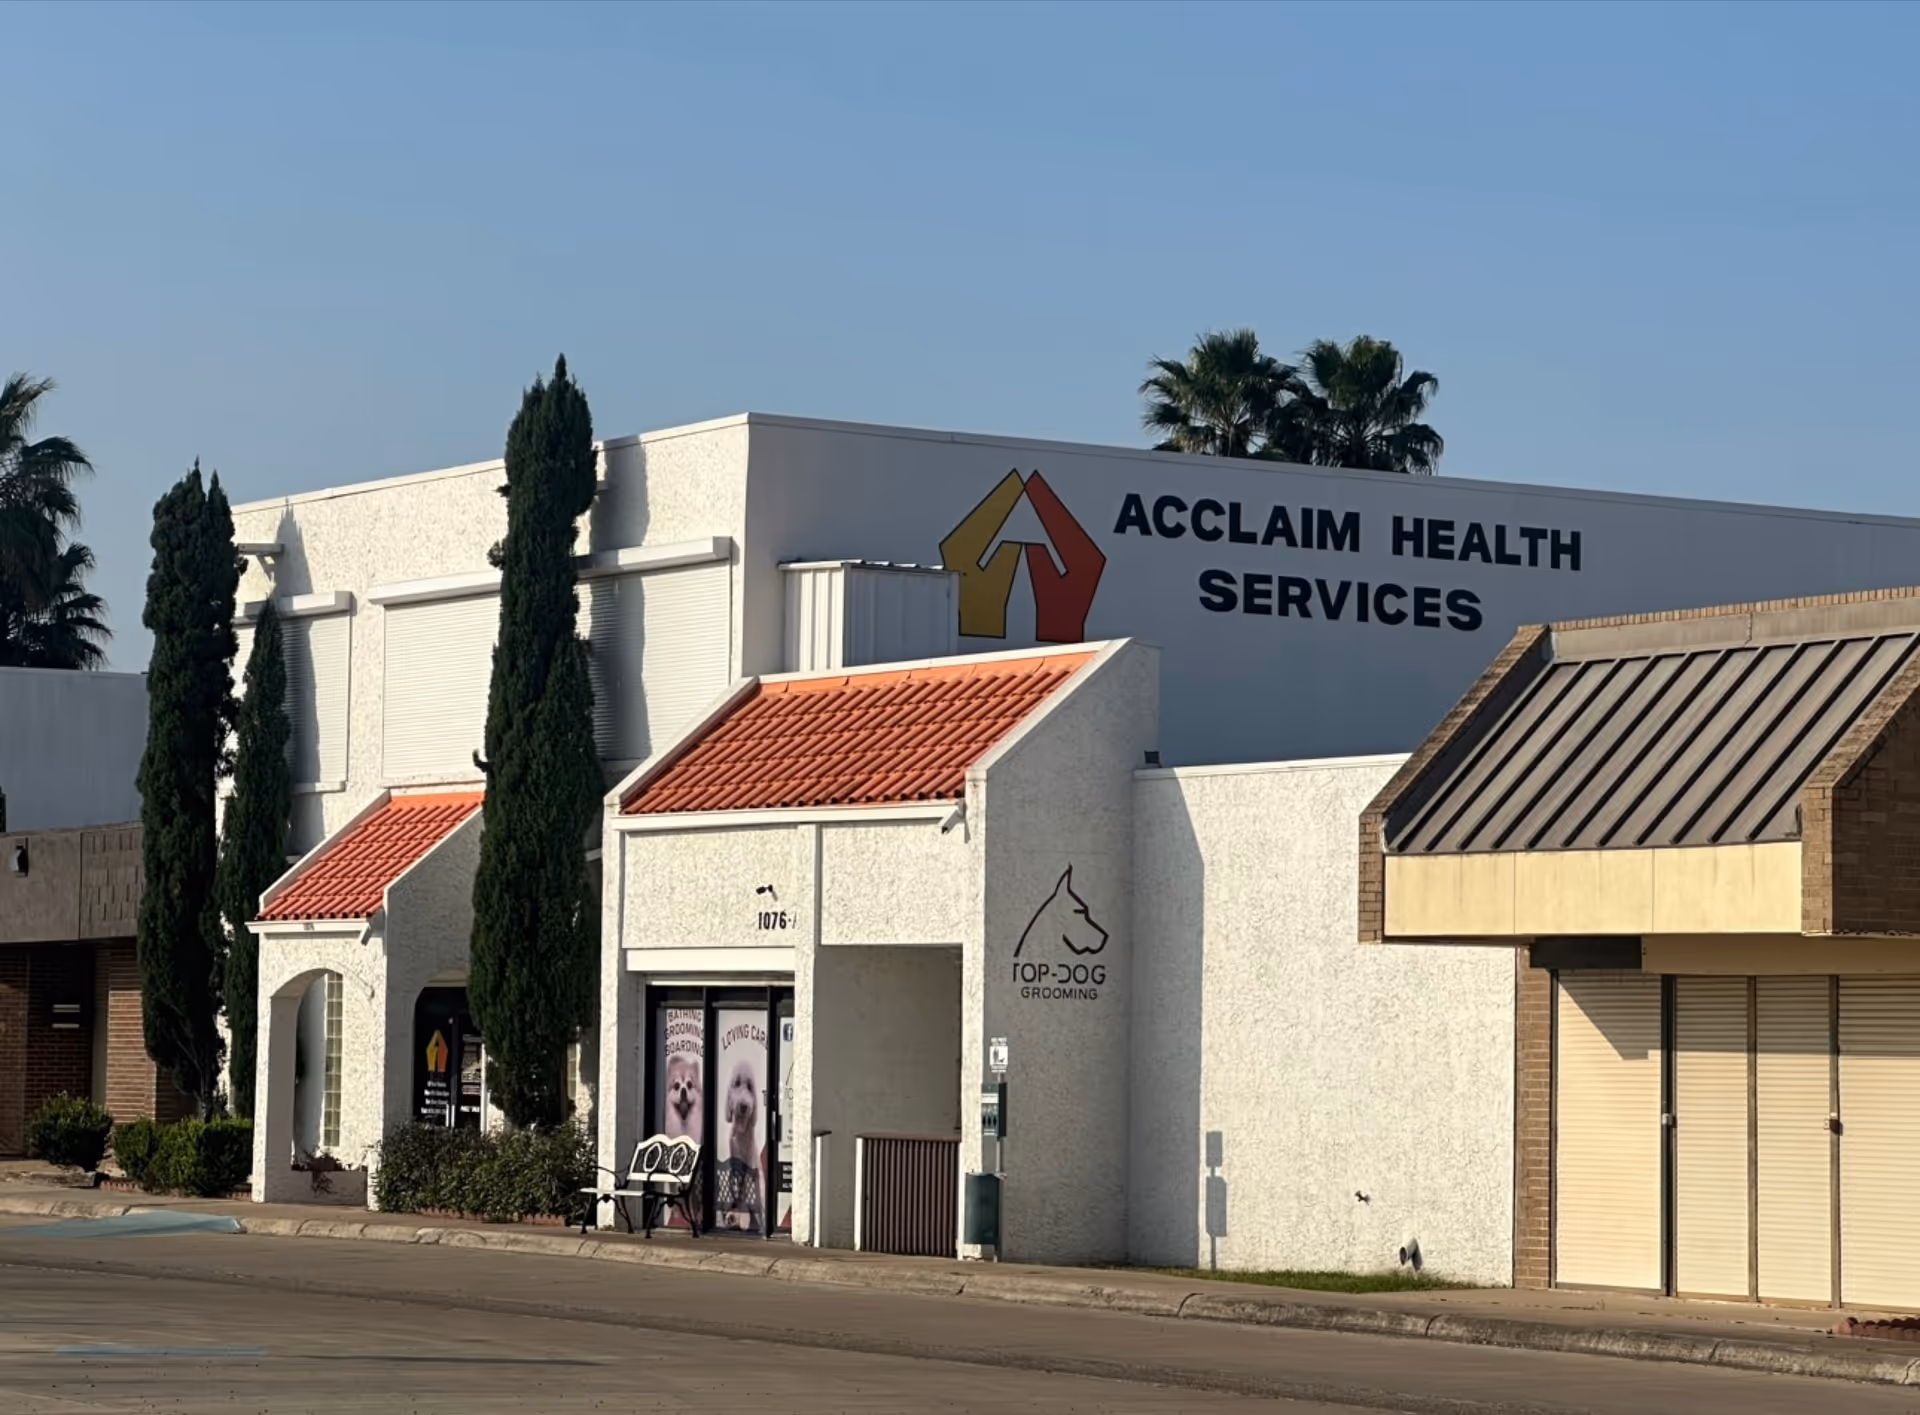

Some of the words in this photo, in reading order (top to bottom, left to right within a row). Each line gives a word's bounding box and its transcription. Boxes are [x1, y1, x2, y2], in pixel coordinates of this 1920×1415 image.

[1113, 493, 1360, 552] ACCLAIM
[1392, 515, 1582, 571] HEALTH
[1198, 569, 1482, 631] SERVICES
[1012, 962, 1107, 985] TOP-DOG
[1020, 986, 1099, 1001] GROOMING
[721, 1023, 750, 1050] LOVING
